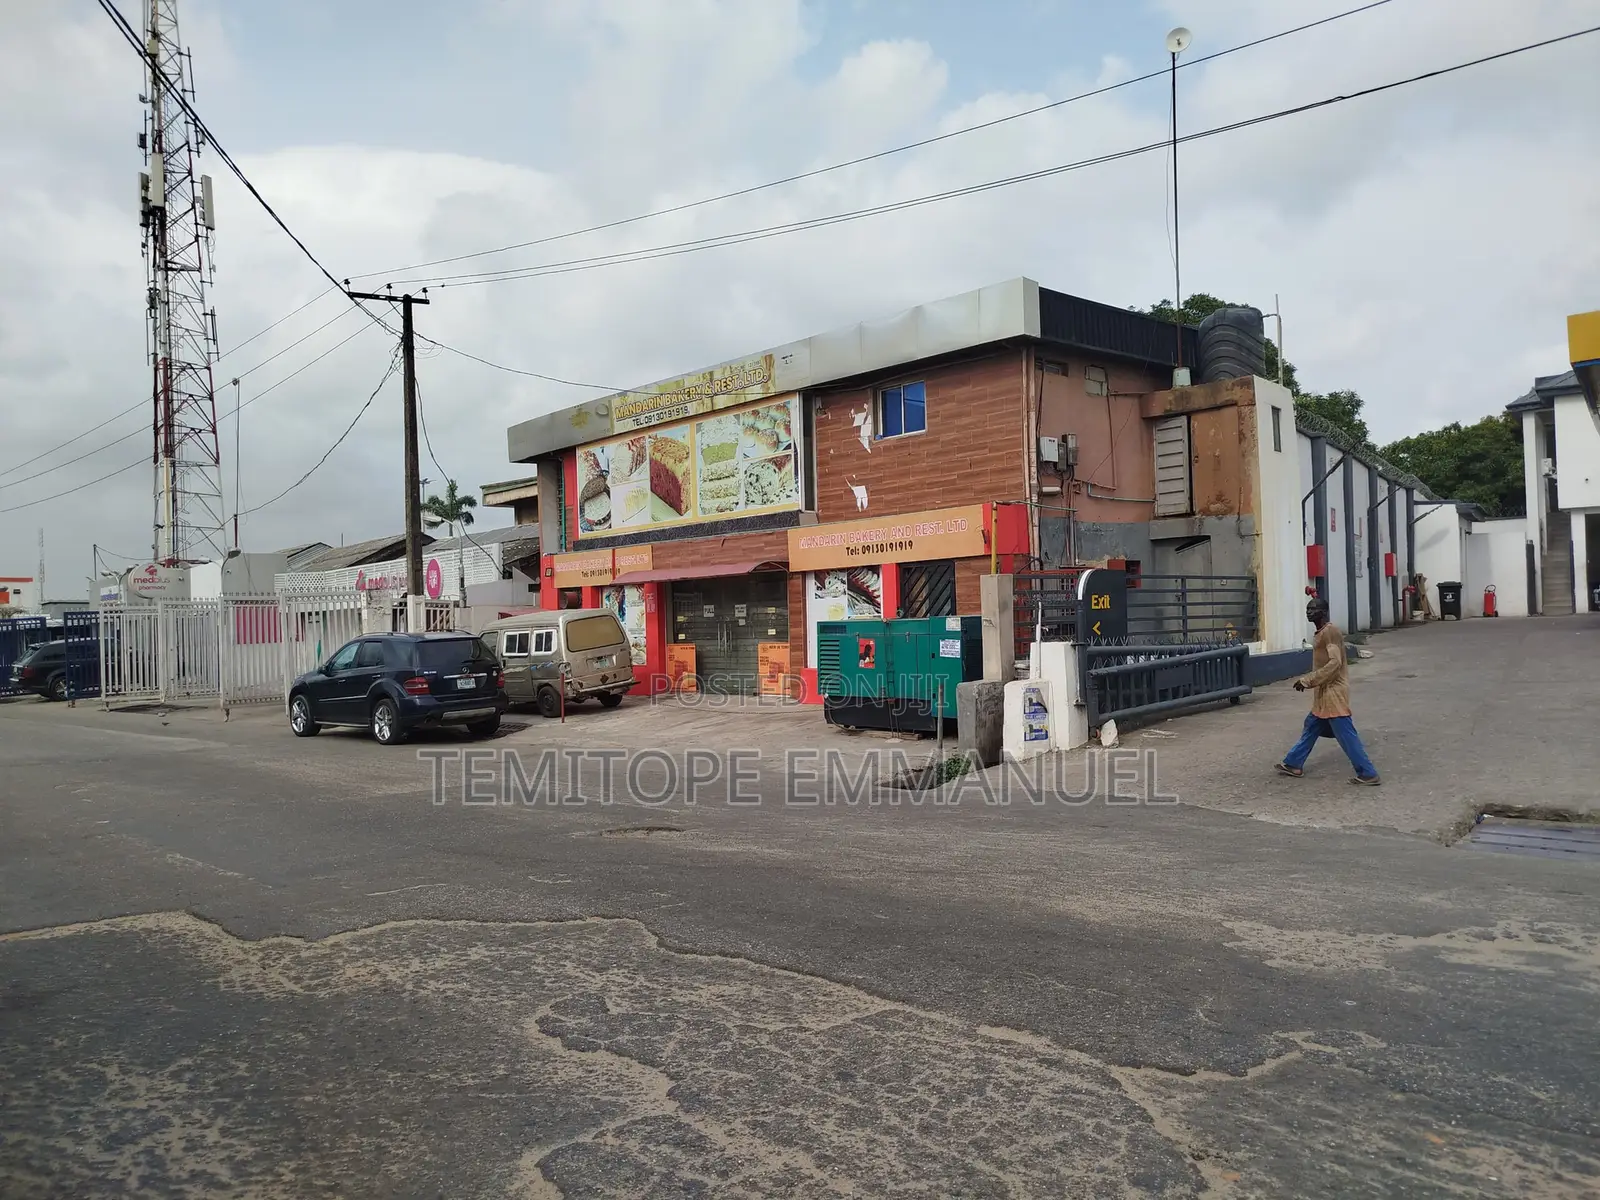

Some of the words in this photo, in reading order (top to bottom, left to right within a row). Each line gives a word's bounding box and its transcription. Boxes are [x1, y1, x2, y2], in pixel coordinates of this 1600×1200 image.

[615, 394, 664, 420] MANDARIN
[664, 383, 703, 407] BAKERY
[704, 380, 713, 397] &
[800, 532, 846, 548] MANDARIN
[848, 527, 887, 543] BAKERY
[890, 524, 912, 540] AND
[915, 521, 944, 536] REST.
[947, 518, 968, 533] LTD
[846, 546, 860, 556] Tel:
[861, 540, 913, 555] 09130191919
[1091, 594, 1111, 610] Exit
